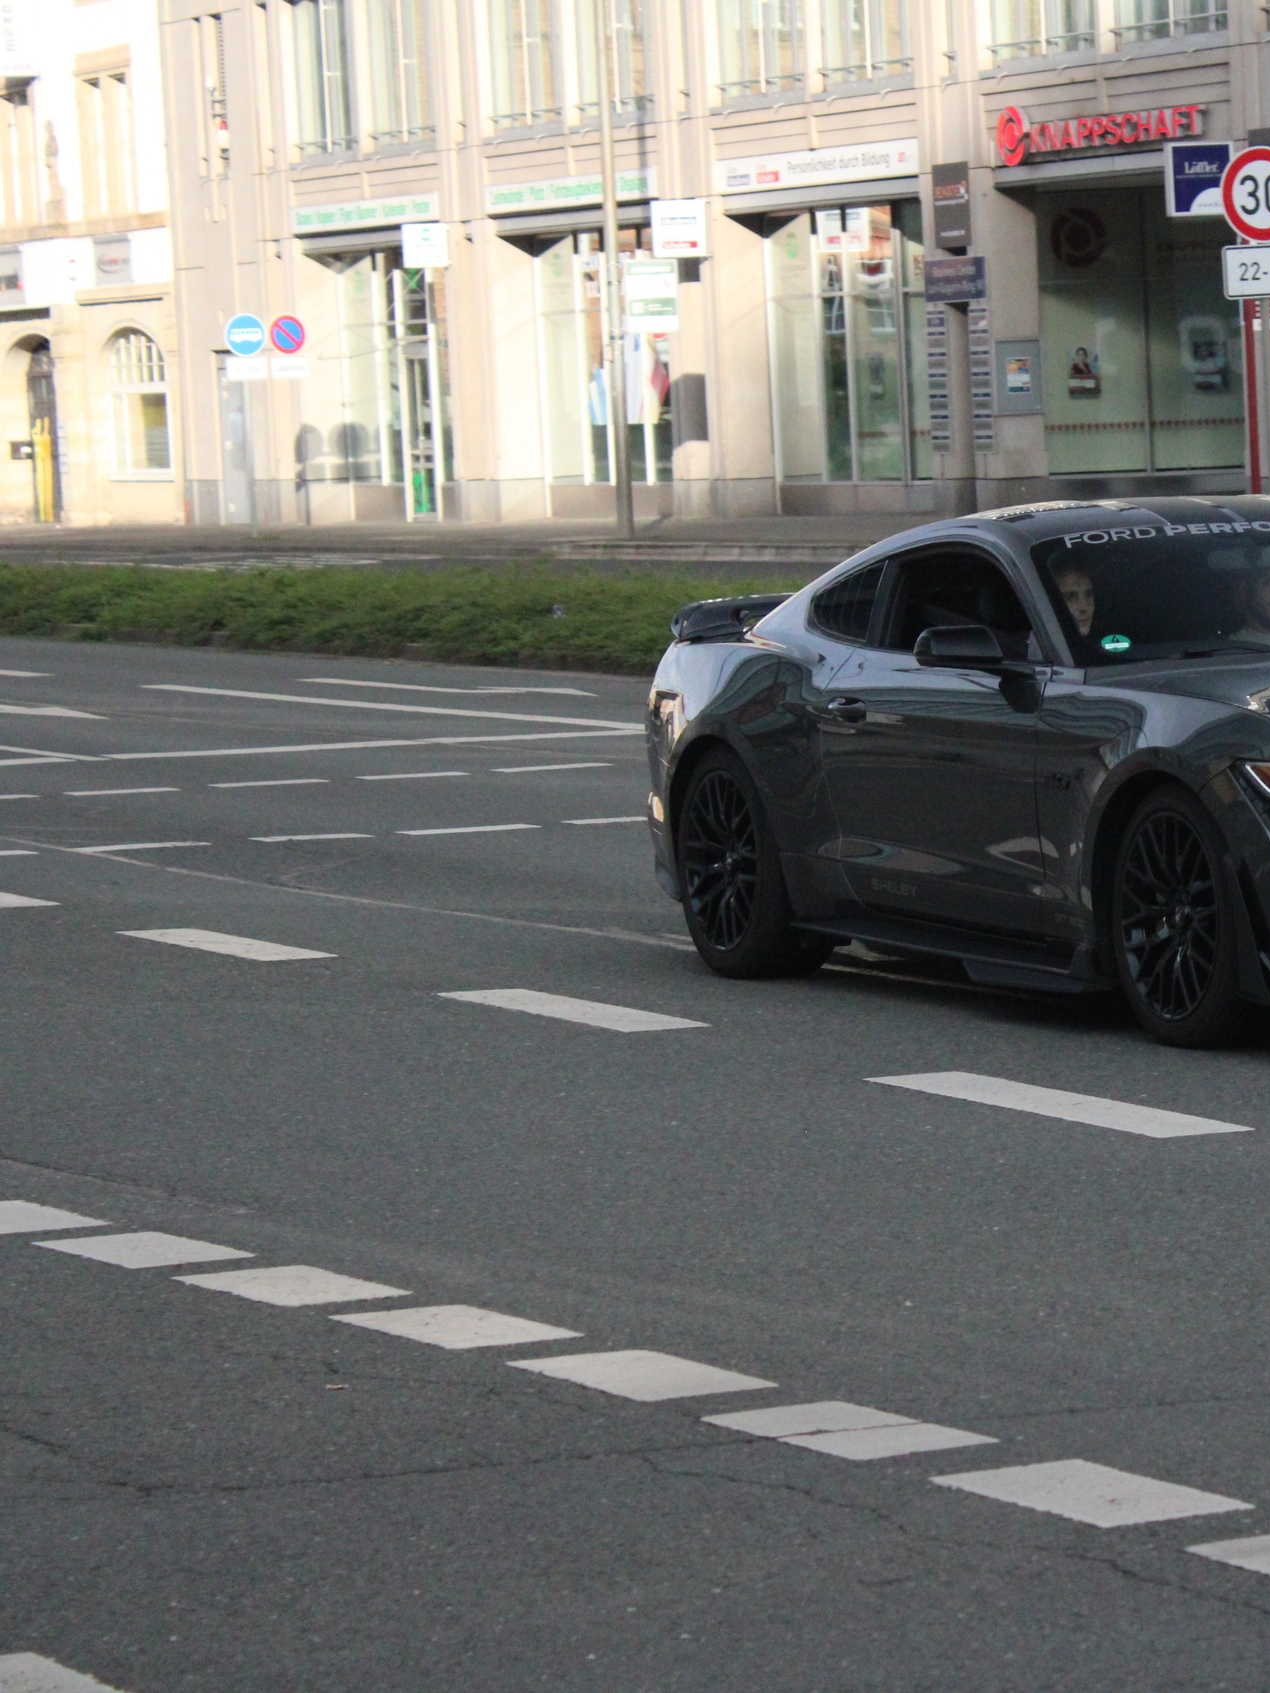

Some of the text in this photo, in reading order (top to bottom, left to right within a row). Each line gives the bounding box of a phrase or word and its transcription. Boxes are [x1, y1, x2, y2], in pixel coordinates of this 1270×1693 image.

[1030, 104, 1203, 153] KNAPPSCHAFT
[1064, 527, 1156, 549] FORD
[1111, 634, 1120, 644] 4
[871, 877, 918, 898] SHELBY
